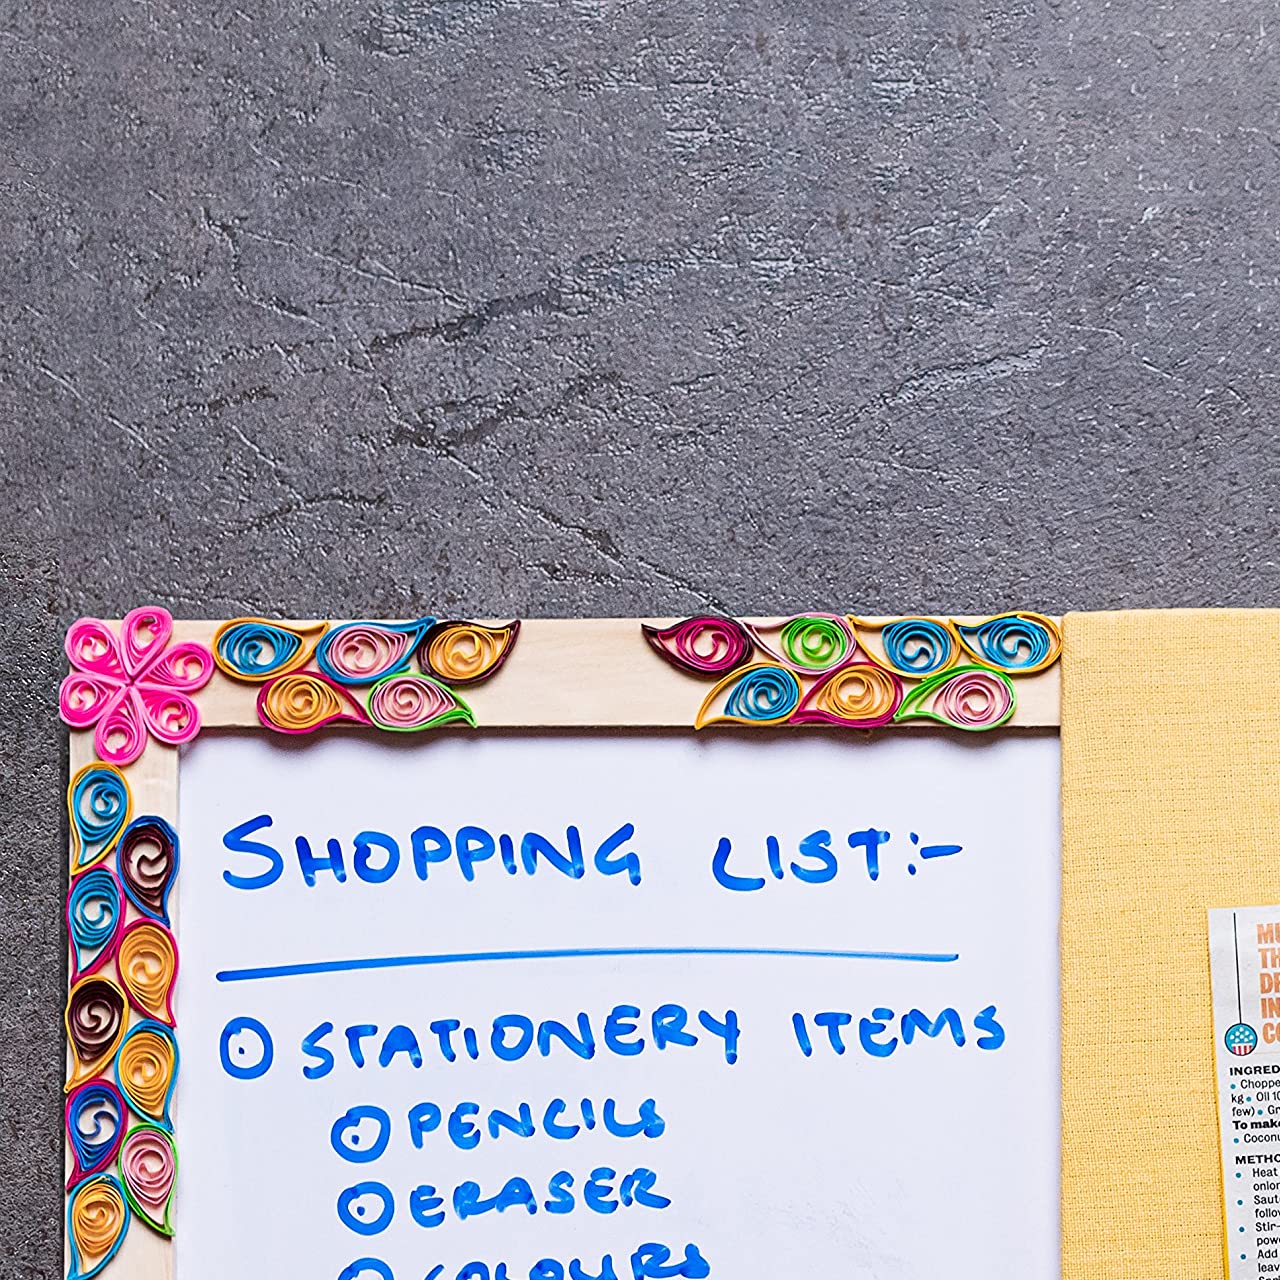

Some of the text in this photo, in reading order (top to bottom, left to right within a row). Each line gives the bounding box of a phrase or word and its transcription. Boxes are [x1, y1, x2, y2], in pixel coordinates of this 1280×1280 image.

[223, 815, 641, 890] SHOPPING
[1260, 996, 1280, 1019] IN
[301, 1004, 1005, 1080] STATIONERY ITEMS
[1231, 1093, 1244, 1105] kg
[1256, 1091, 1270, 1102] Oil
[1231, 1106, 1255, 1117] few)
[408, 1098, 665, 1150] PENCILS
[1231, 1120, 1248, 1130] To
[1252, 1167, 1278, 1178] Heat
[410, 1167, 671, 1228] ERASER
[1257, 1248, 1278, 1259] Add
